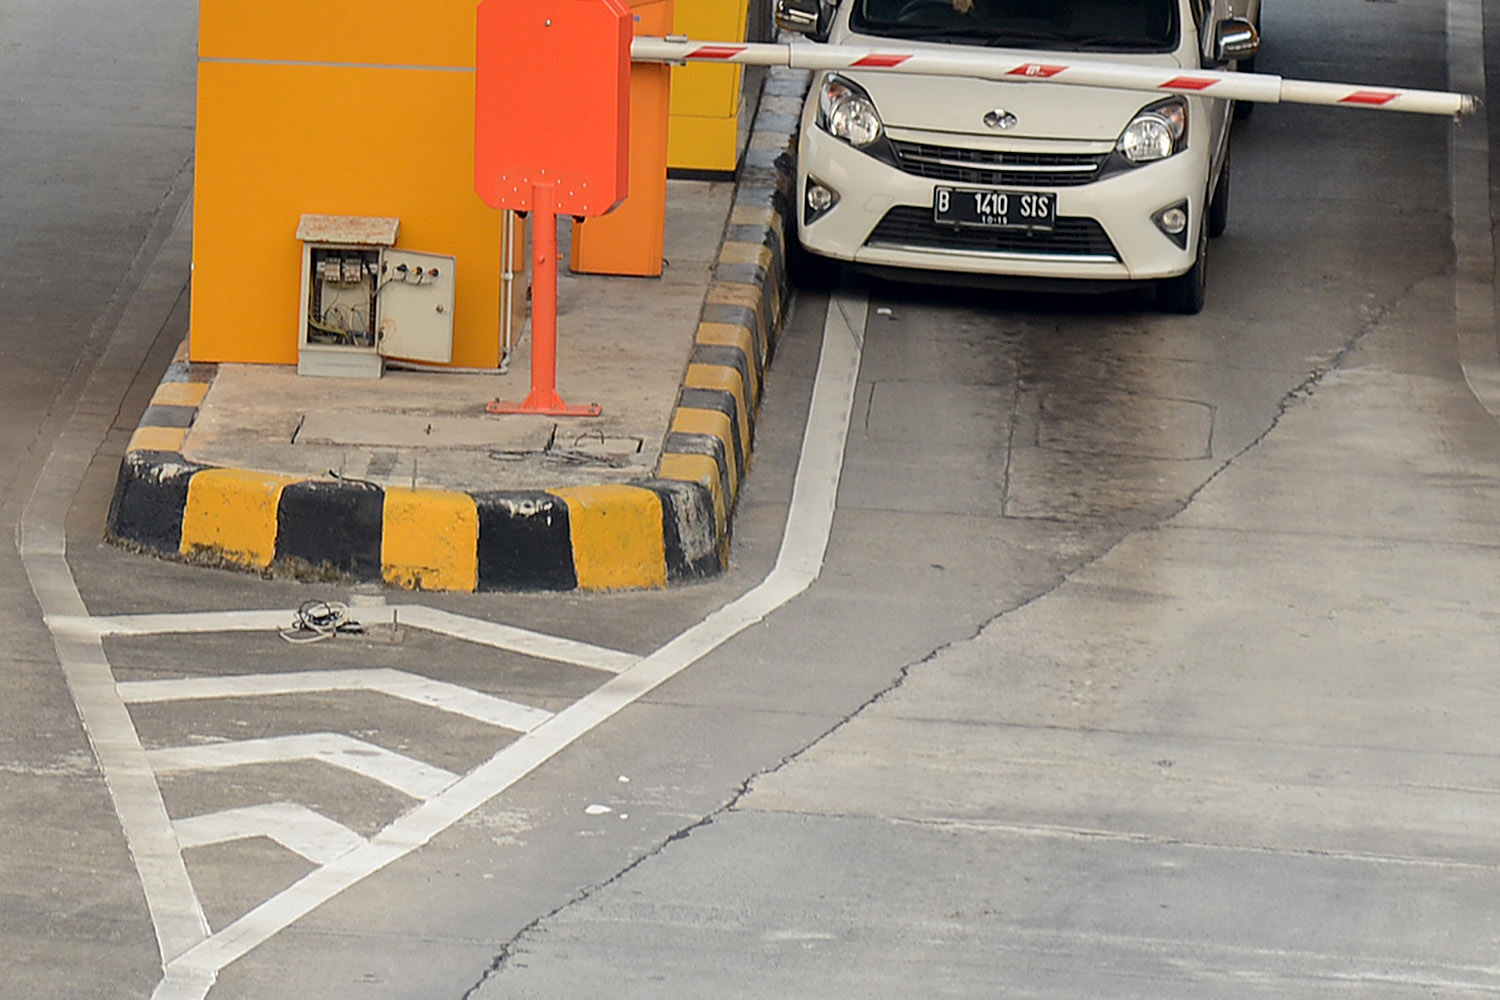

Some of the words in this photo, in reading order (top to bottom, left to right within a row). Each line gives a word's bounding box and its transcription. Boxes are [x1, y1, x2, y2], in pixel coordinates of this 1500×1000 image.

[939, 190, 950, 213] B
[975, 193, 1008, 216] 1410
[1020, 195, 1049, 218] SIS
